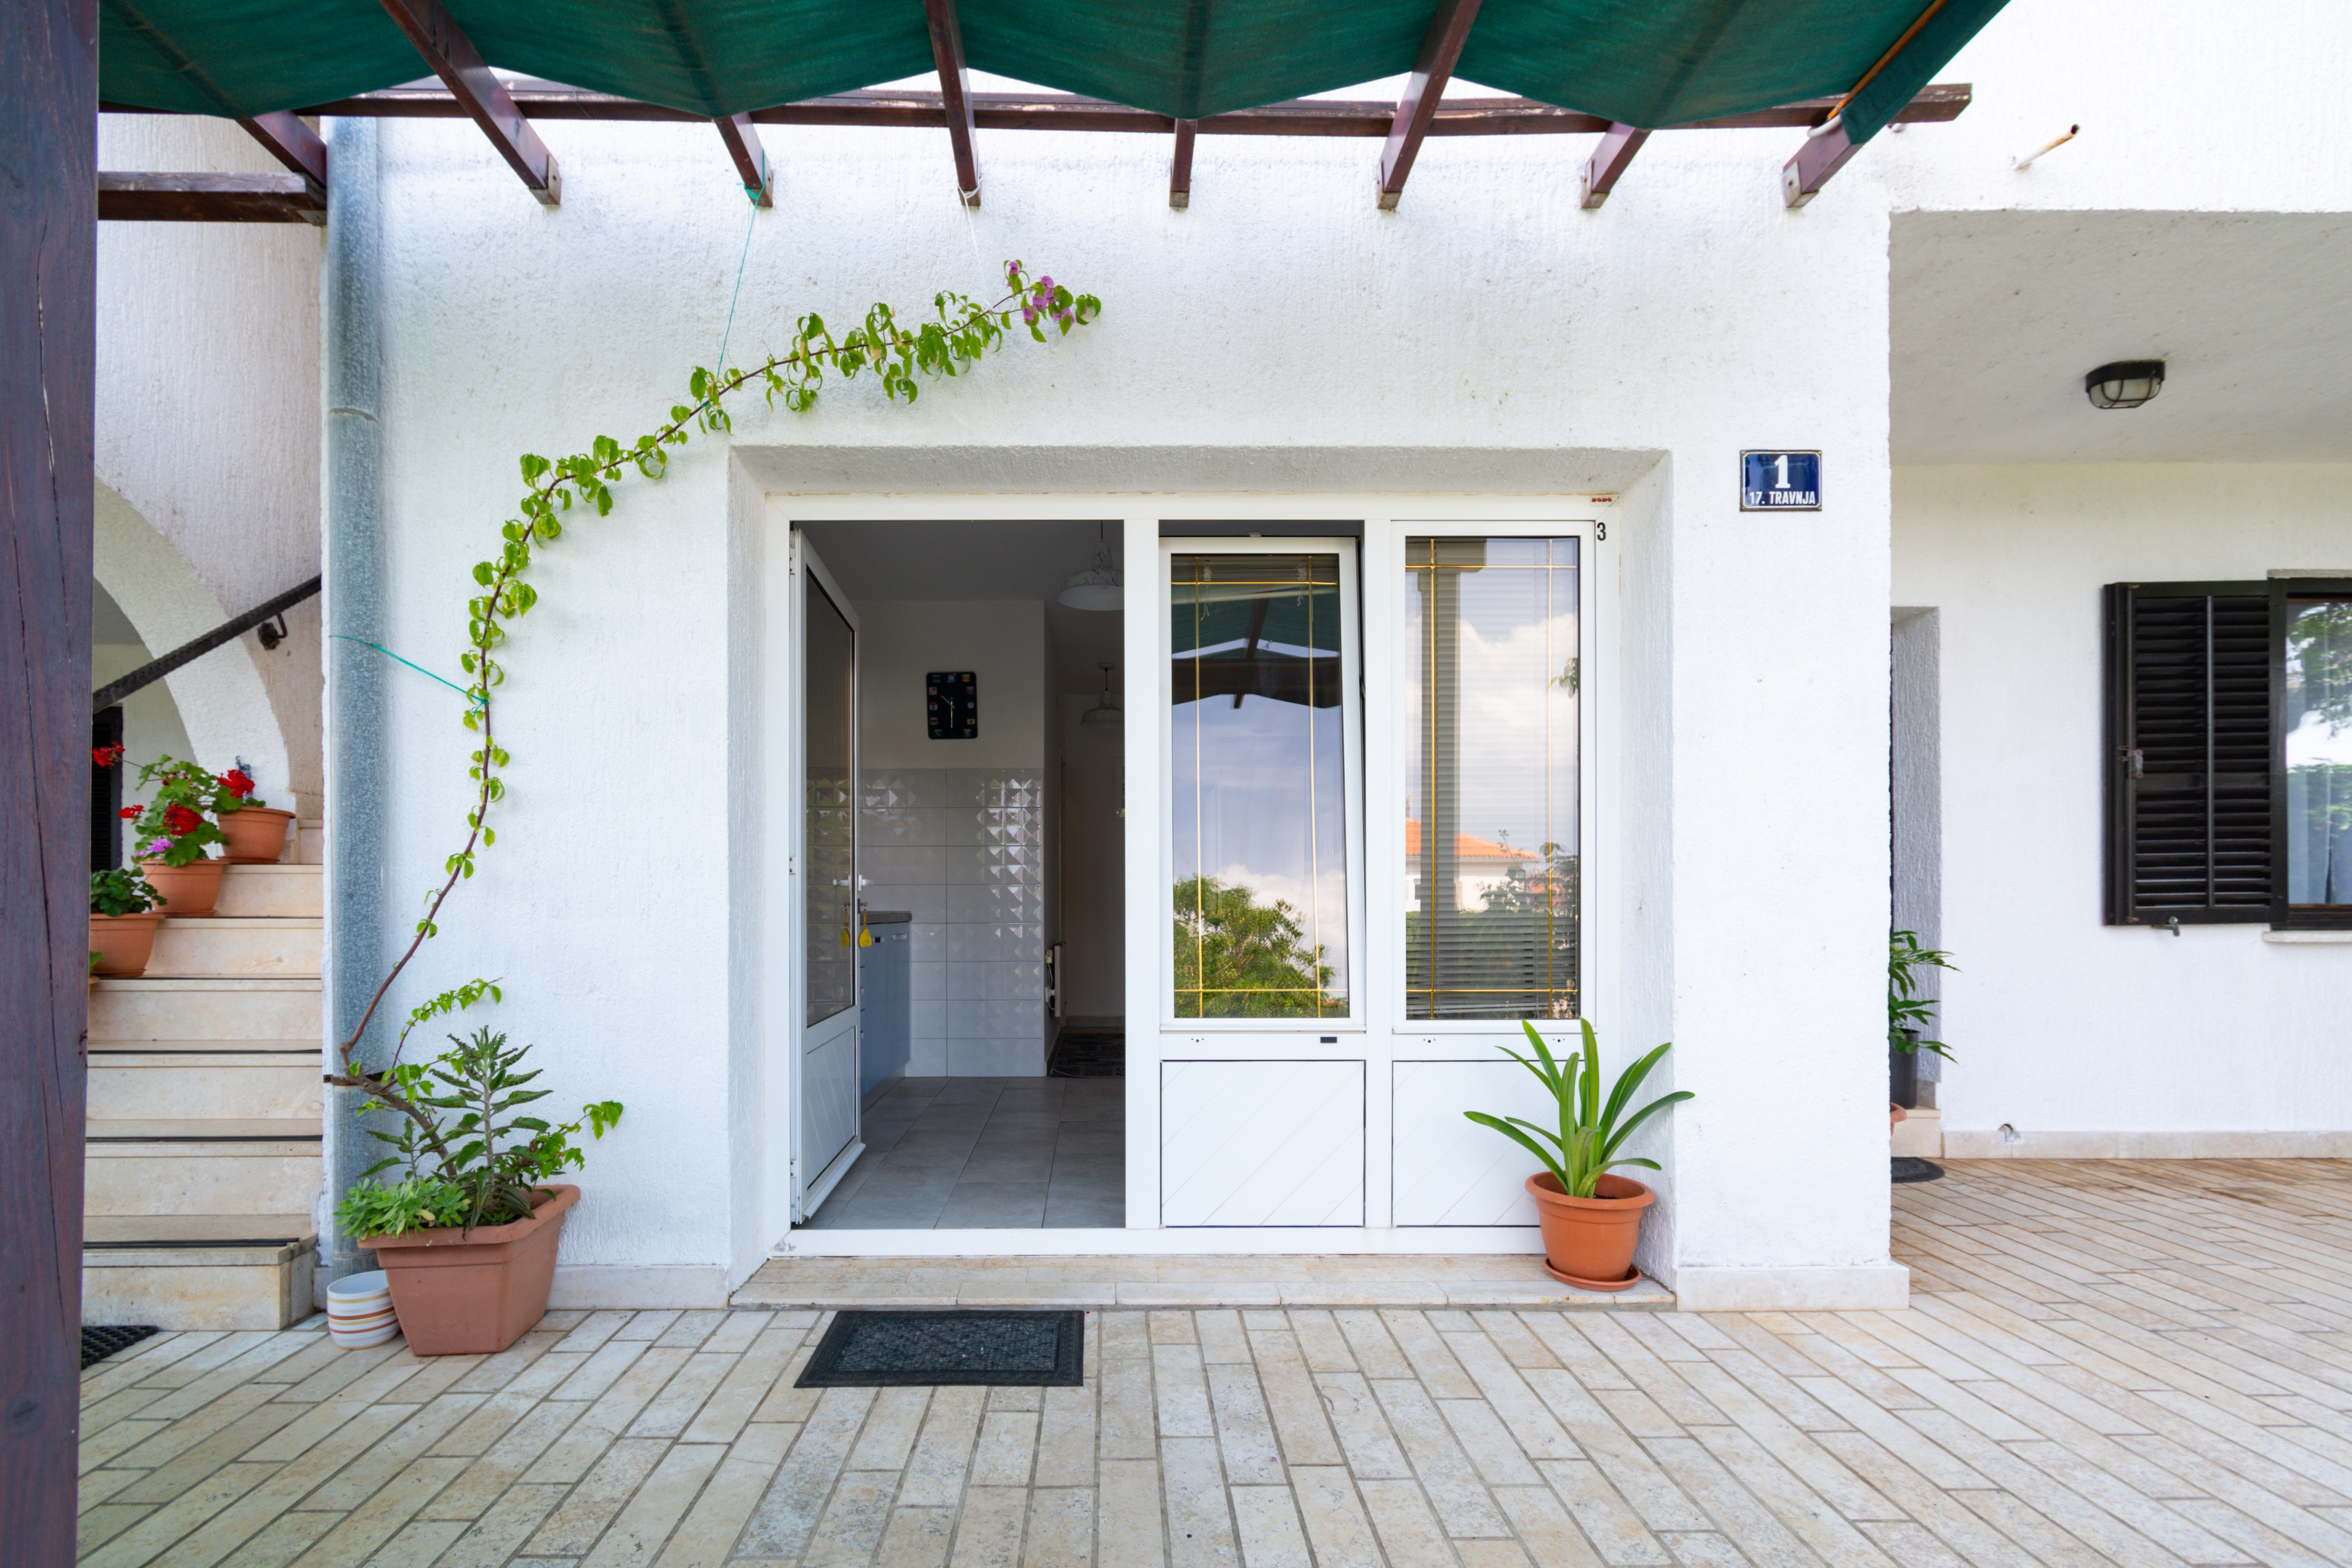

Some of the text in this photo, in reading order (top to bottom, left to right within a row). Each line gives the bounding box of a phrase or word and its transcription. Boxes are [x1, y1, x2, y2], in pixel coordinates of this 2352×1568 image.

[1775, 455, 1791, 489] 1
[1749, 492, 1816, 504] 17. TRAVNJA
[1597, 522, 1607, 541] 3
